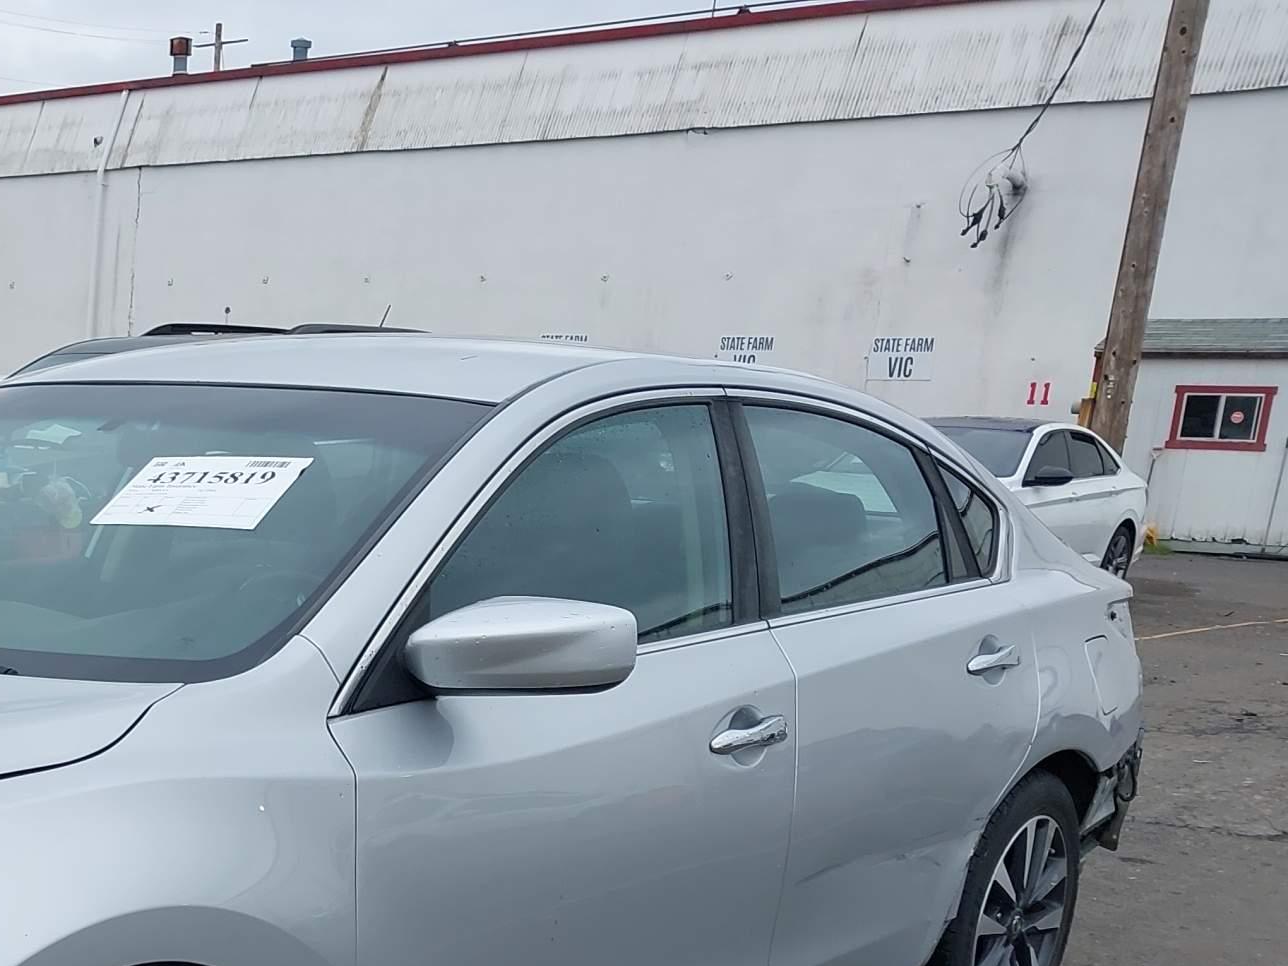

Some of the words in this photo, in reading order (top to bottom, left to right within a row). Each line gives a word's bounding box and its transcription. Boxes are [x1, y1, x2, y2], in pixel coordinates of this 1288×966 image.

[720, 336, 745, 351] STATE
[747, 336, 774, 351] FARM
[873, 337, 903, 352] STATE
[904, 337, 935, 352] FARM
[888, 356, 914, 378] VIC
[1026, 382, 1051, 405] 11
[147, 470, 276, 485] 43715819
